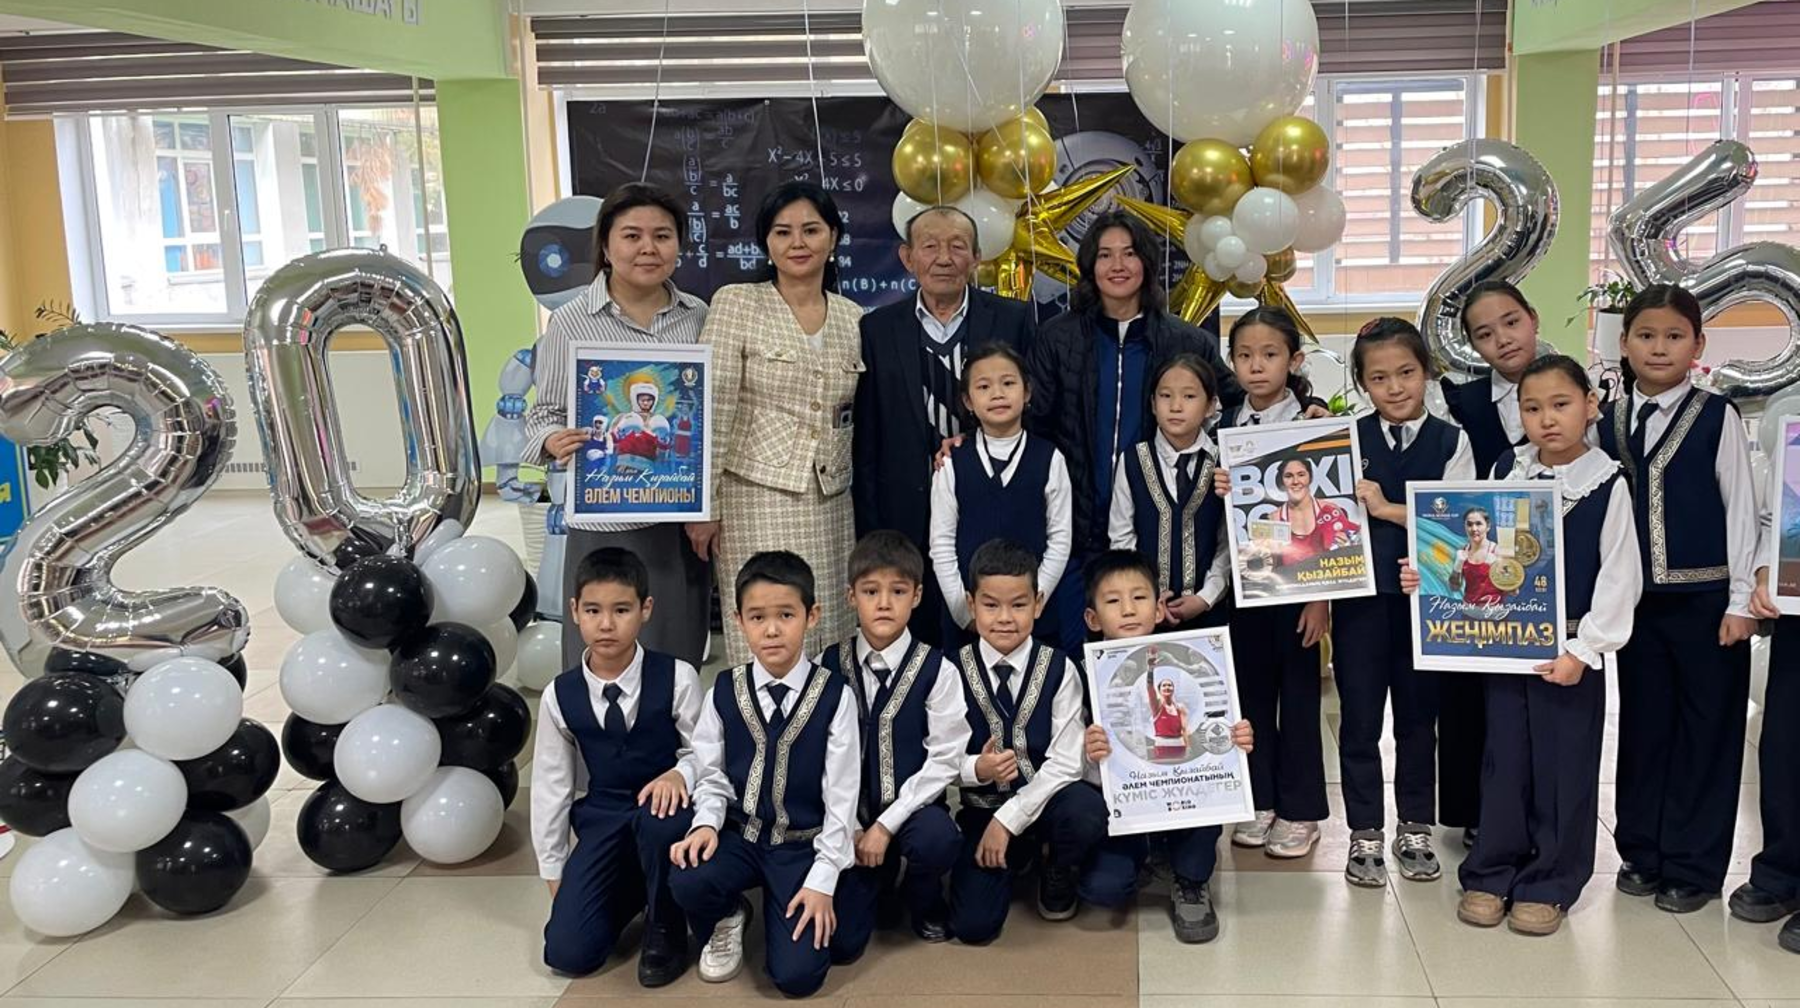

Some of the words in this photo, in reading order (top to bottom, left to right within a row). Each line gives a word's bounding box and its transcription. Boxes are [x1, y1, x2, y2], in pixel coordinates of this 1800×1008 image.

[727, 242, 763, 255] ad+b
[585, 487, 621, 504] ӘЛЕМ
[623, 488, 696, 504] ЧЕМПИОНЫ
[1320, 554, 1365, 568] НАЗЫМ
[1297, 564, 1367, 582] ҚЫЗАЙБАЙ
[1534, 575, 1548, 587] 48
[1425, 620, 1555, 649] ЖЕҢІМПАЗ
[1121, 781, 1148, 791] ӘЛЕМ
[1148, 771, 1235, 788] ЧЕМПИОНАТЫНЫҢ
[1112, 788, 1159, 804] КҮМІС
